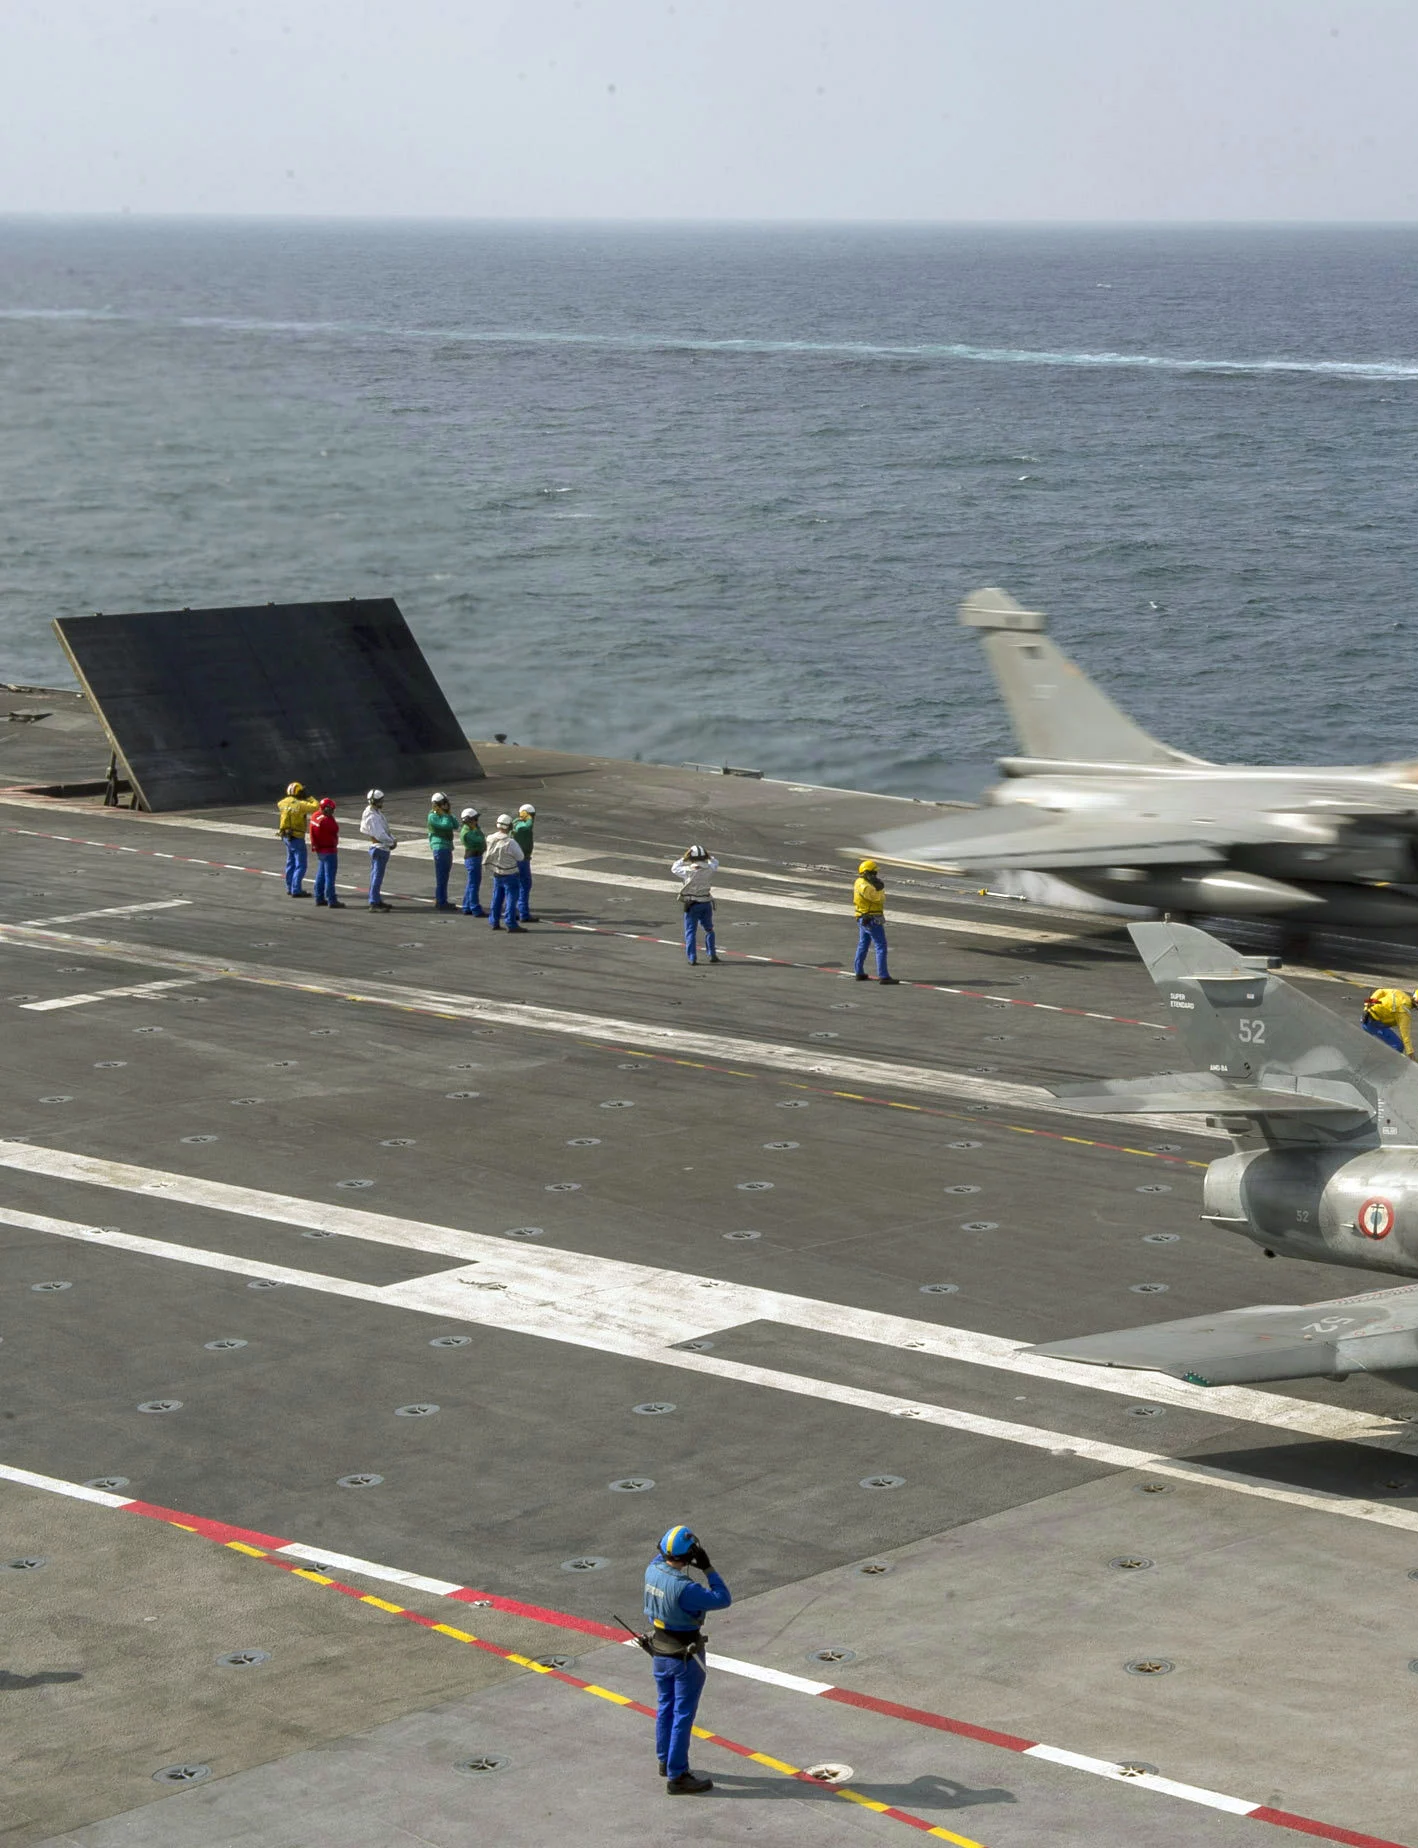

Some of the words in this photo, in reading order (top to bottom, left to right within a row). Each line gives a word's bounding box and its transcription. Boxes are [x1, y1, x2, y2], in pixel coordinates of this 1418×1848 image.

[1238, 1018, 1266, 1044] 52
[1296, 1209, 1310, 1223] 52
[1300, 1315, 1356, 1333] 52
